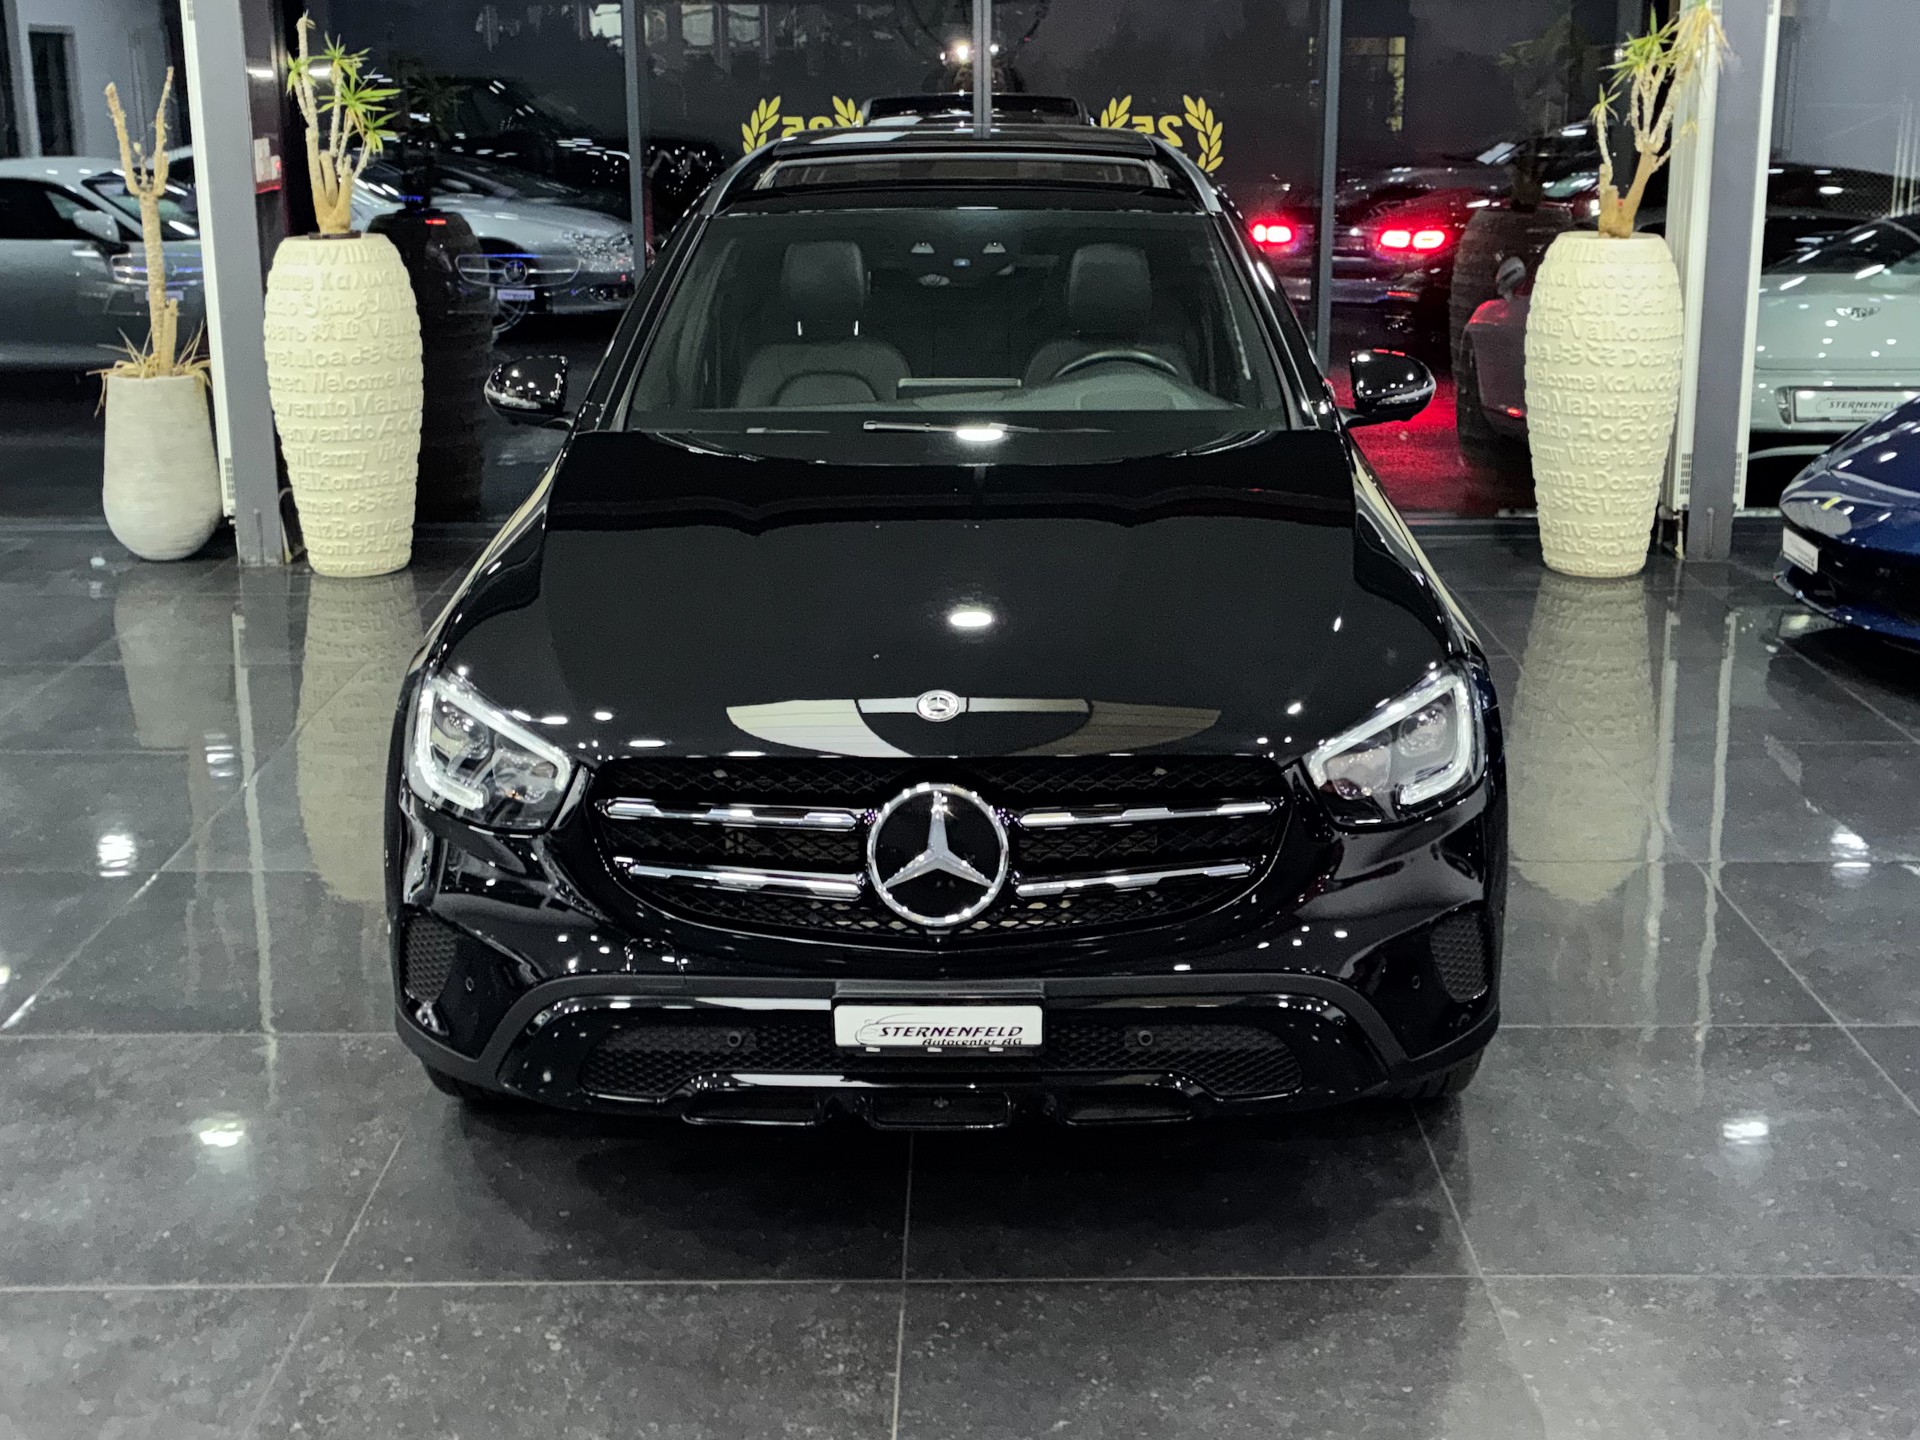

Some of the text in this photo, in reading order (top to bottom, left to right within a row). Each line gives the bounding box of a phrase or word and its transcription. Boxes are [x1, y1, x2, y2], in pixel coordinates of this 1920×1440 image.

[879, 1026, 1023, 1038] STERNENFELD
[922, 1038, 1023, 1046] Autocenter AG
